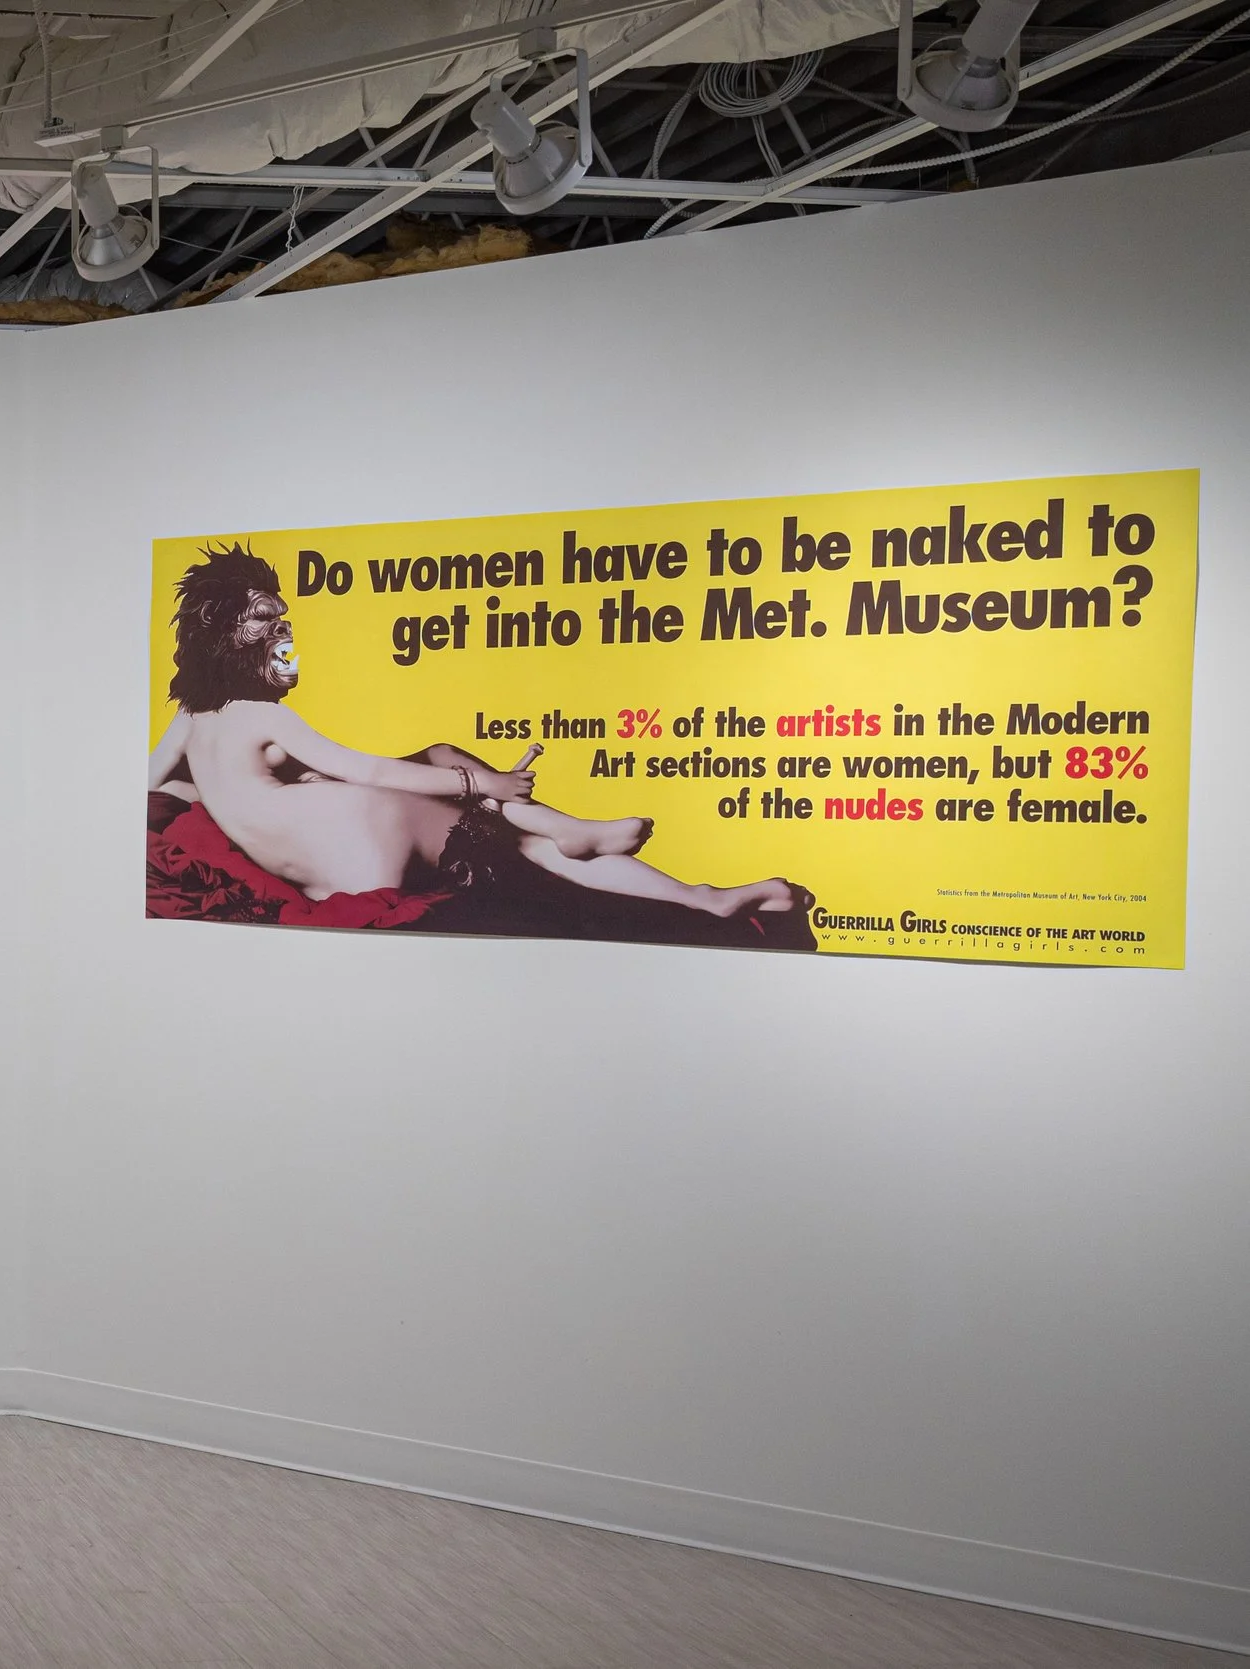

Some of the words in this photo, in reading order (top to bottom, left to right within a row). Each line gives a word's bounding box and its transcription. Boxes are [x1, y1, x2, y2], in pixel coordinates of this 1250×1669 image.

[297, 550, 353, 597] Do
[368, 549, 544, 594] women
[562, 530, 688, 584] have
[707, 529, 762, 576] to
[781, 516, 851, 573] be
[871, 498, 1064, 568] naked
[1088, 504, 1155, 557] to
[392, 603, 470, 666] get
[486, 595, 582, 650] into
[598, 589, 684, 644] the
[701, 586, 827, 641] Met.
[845, 564, 1153, 636] Museum?
[475, 712, 531, 740] Less
[541, 710, 605, 739] than
[616, 708, 662, 740] 3%
[673, 707, 705, 738] of
[715, 706, 766, 738] the
[776, 705, 881, 737] artists
[894, 704, 924, 736] in
[937, 703, 995, 736] the
[1006, 701, 1150, 736] Modern
[589, 749, 636, 779] Art
[646, 747, 767, 779] sections
[777, 754, 832, 779] are
[843, 754, 979, 785] women,
[992, 745, 1052, 780] but
[1064, 745, 1149, 780] 83%
[718, 788, 750, 819] of
[760, 788, 813, 820] the
[825, 788, 923, 821] nudes
[935, 798, 995, 822] are
[1007, 789, 1148, 824] female.
[992, 891, 1030, 899] Metropolitan
[951, 924, 1022, 937] CONSCIENCE
[1026, 927, 1041, 937] OF
[1046, 928, 1068, 939] THE
[1072, 929, 1096, 940] ART
[1100, 930, 1145, 942] WORLD
